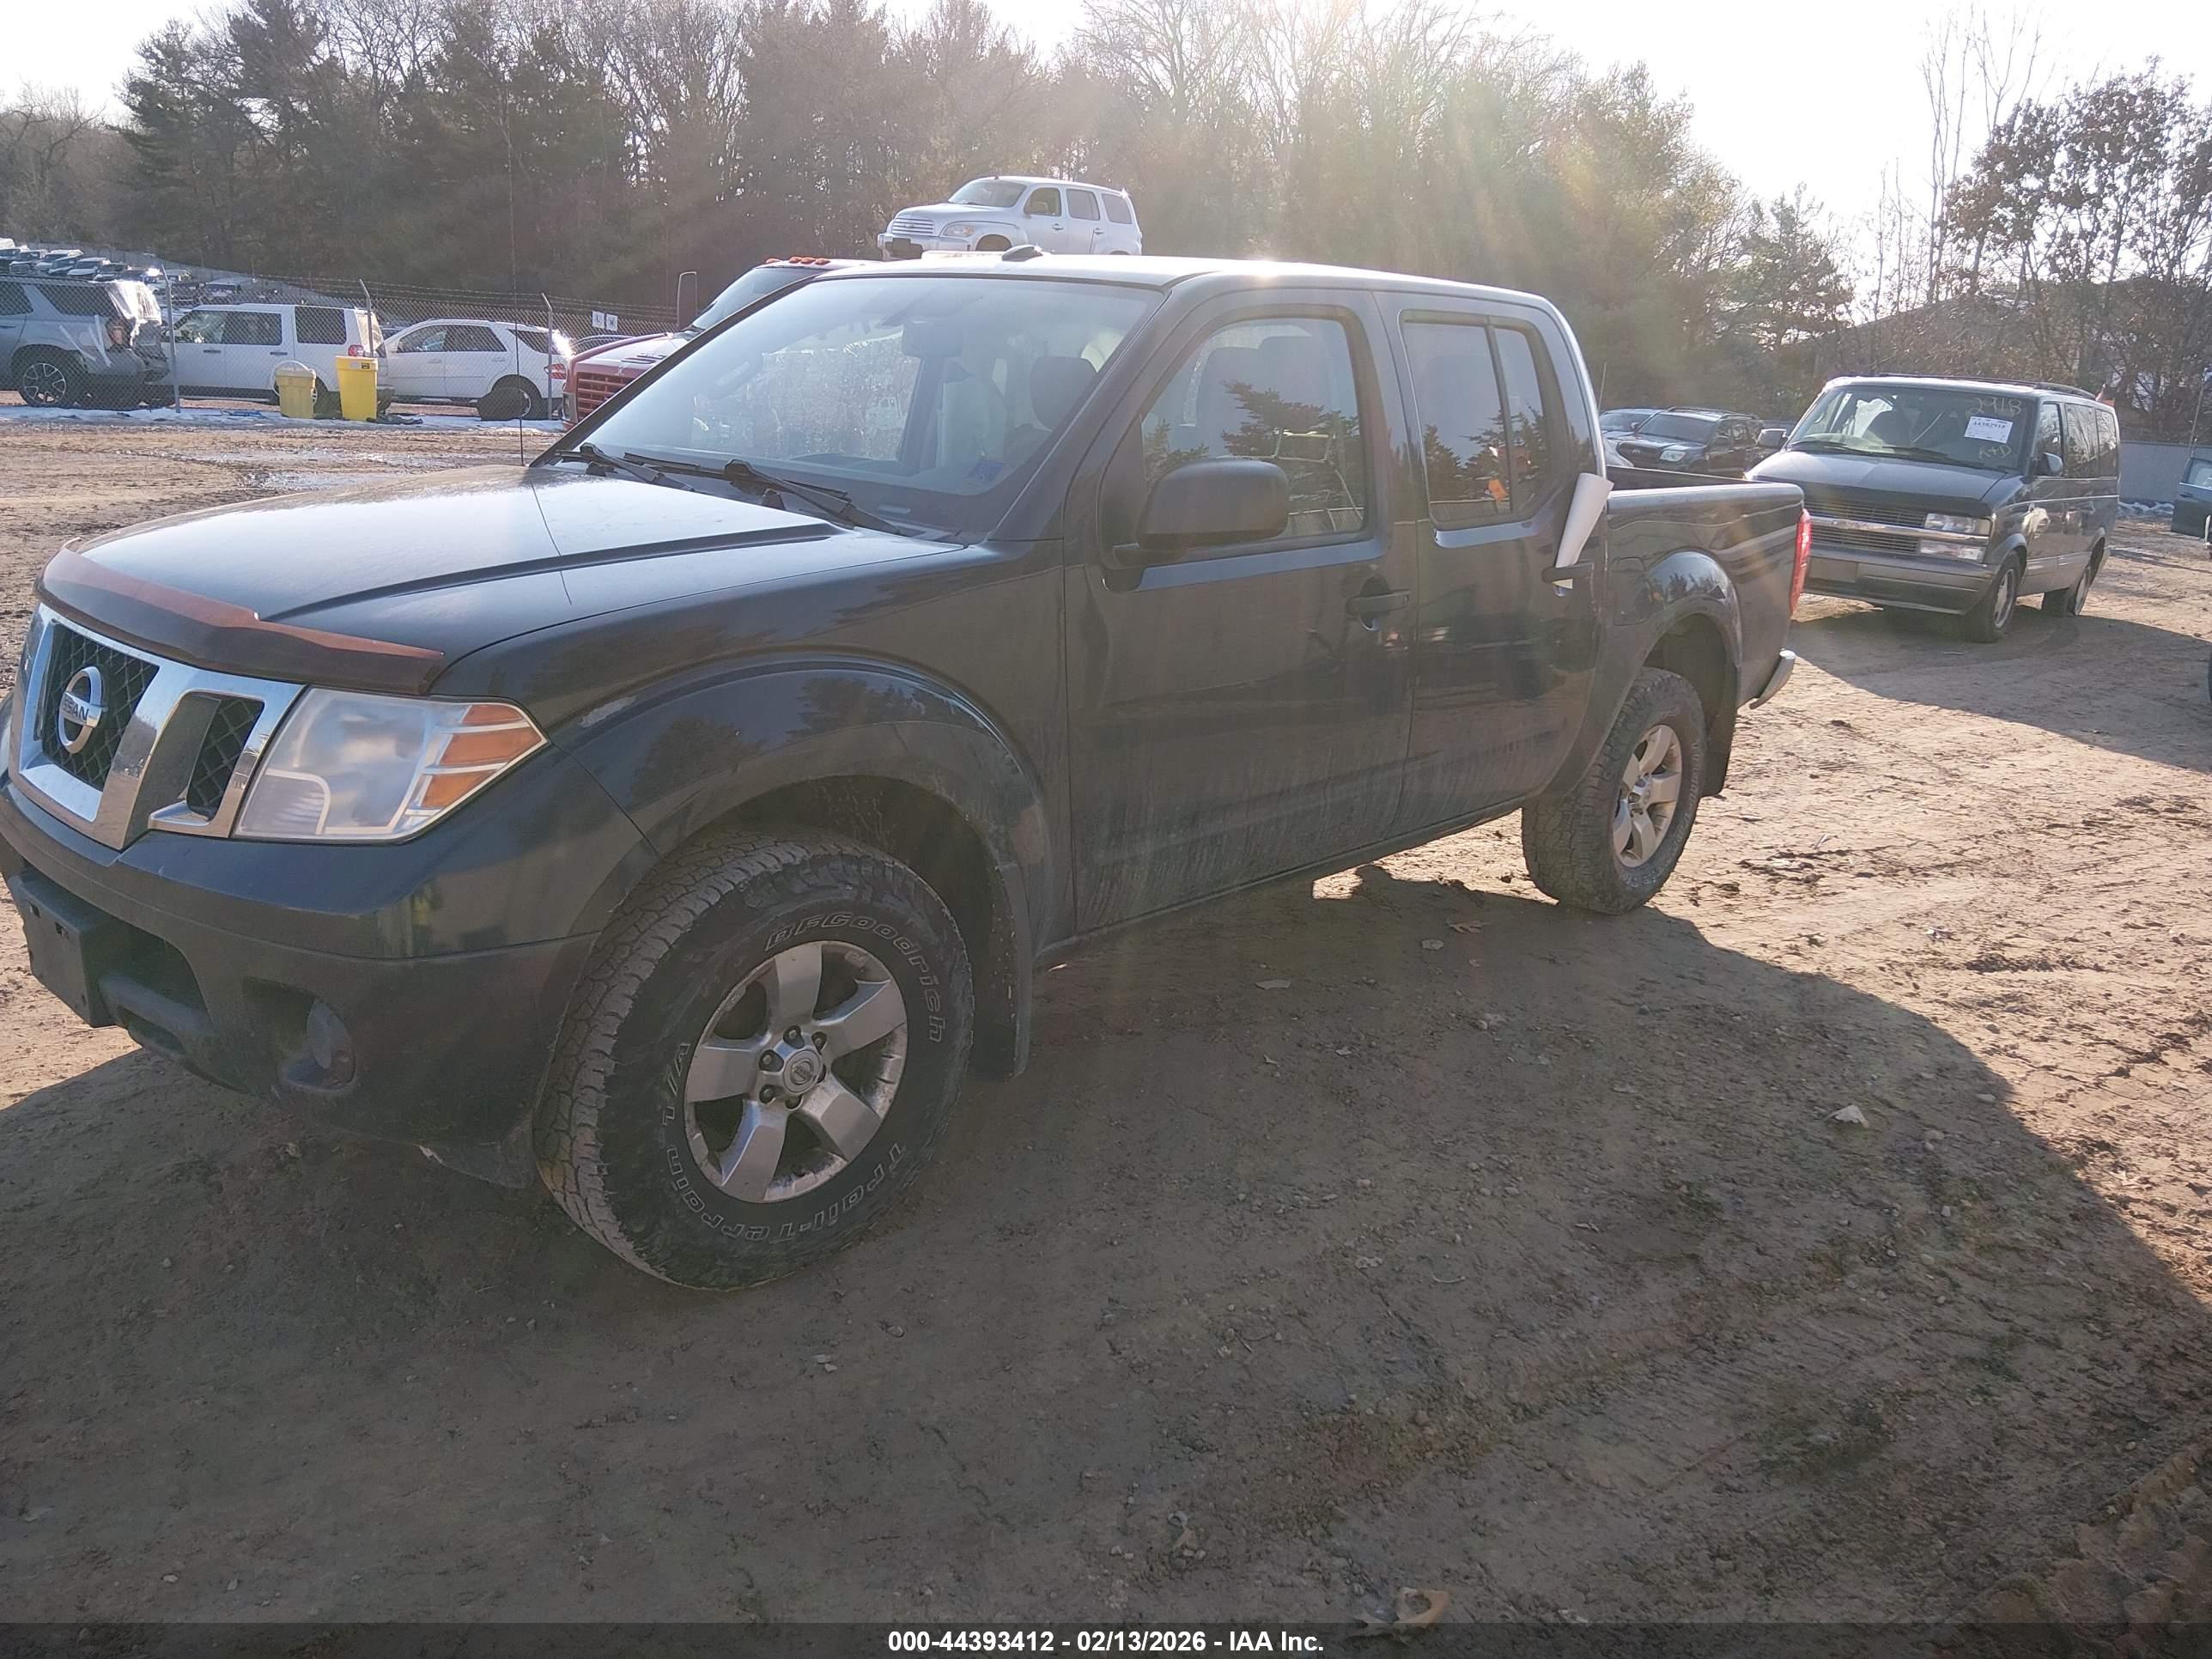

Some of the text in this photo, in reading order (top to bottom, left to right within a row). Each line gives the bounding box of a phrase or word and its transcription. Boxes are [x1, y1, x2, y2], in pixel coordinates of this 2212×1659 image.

[1968, 398, 2022, 416] 2918
[764, 910, 945, 1043] BFGoodrich
[662, 1043, 690, 1127] T/A
